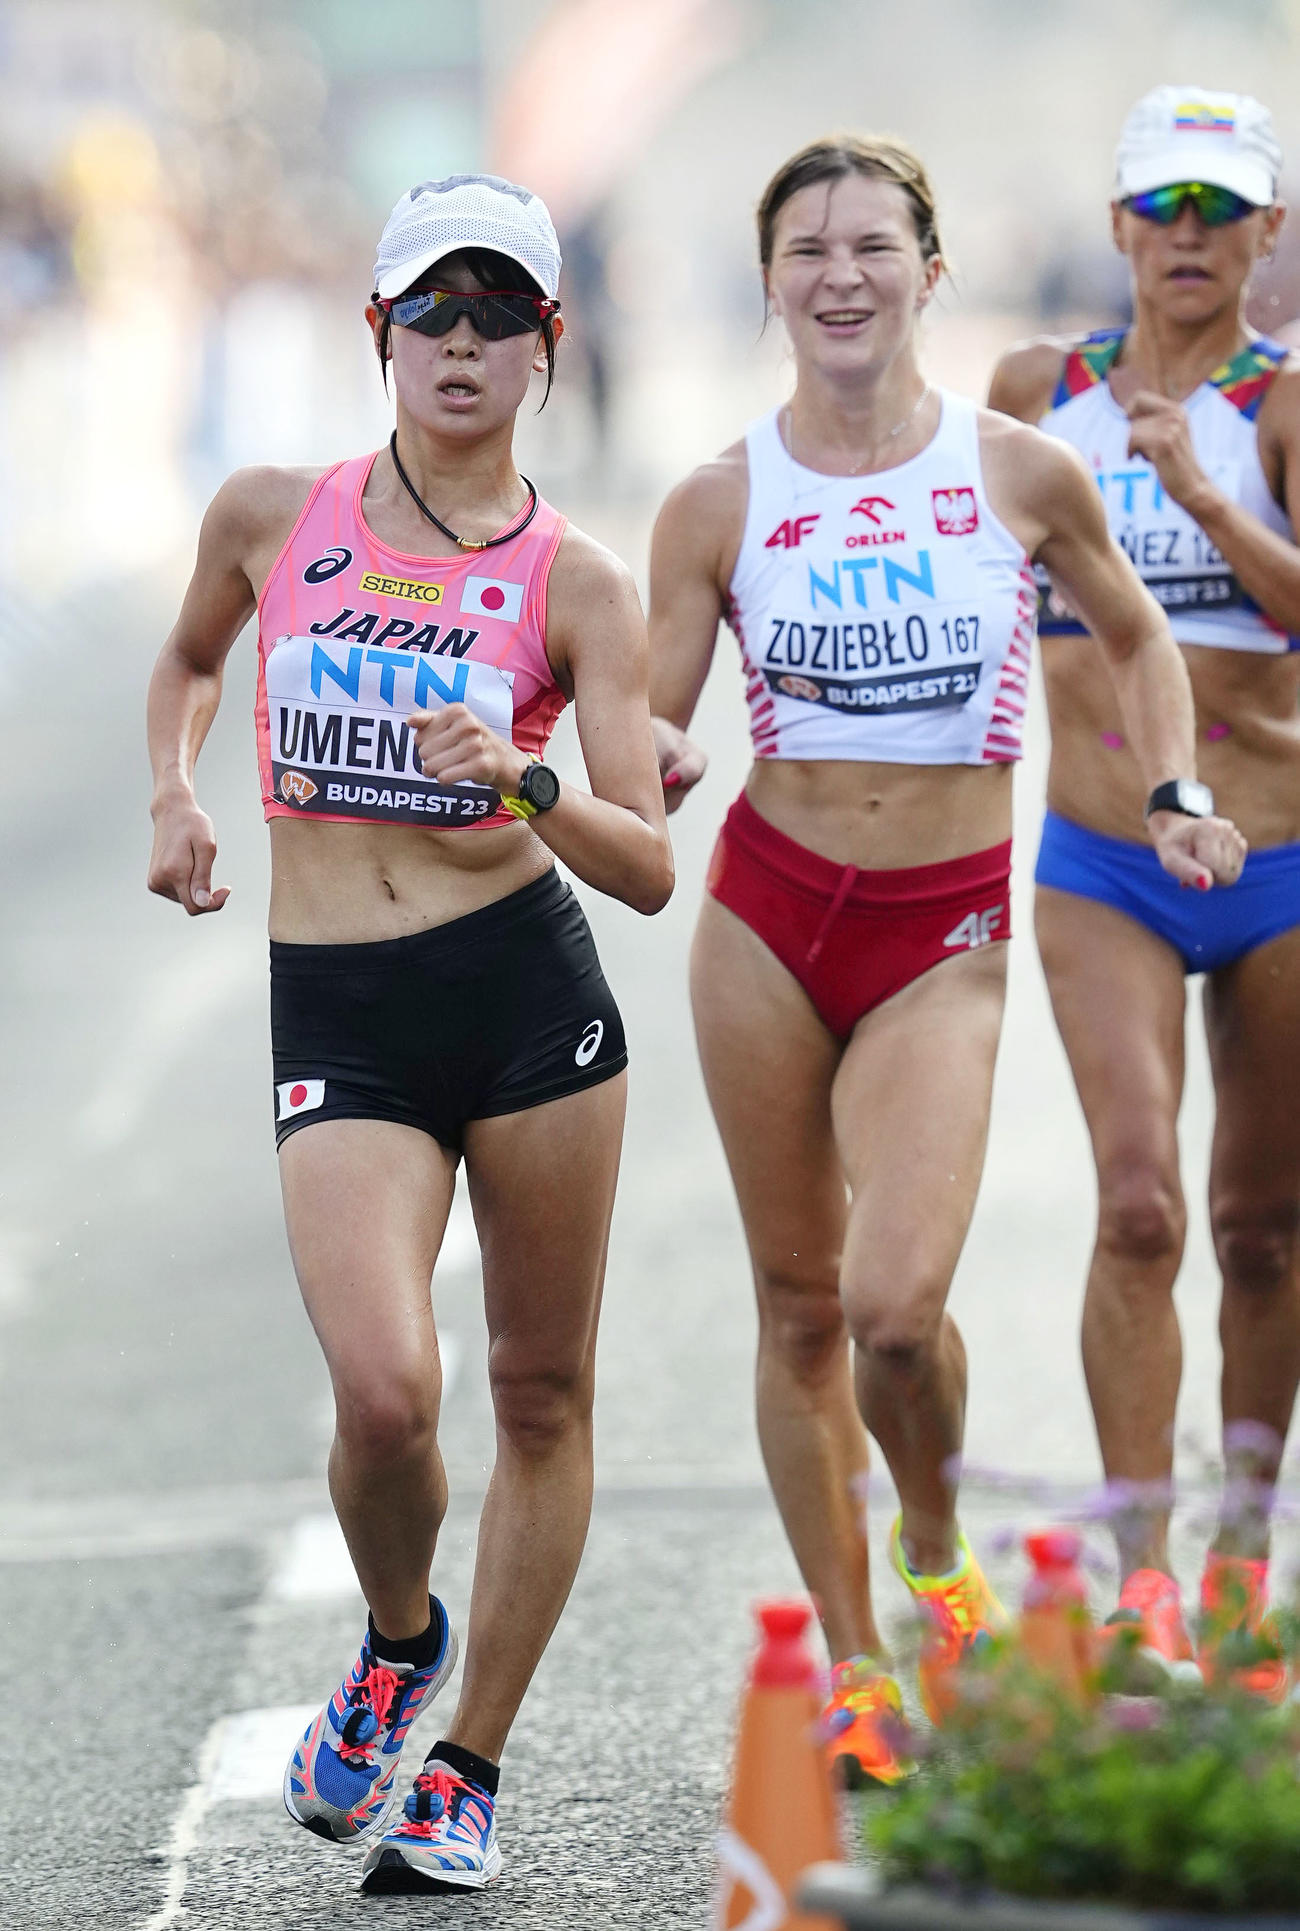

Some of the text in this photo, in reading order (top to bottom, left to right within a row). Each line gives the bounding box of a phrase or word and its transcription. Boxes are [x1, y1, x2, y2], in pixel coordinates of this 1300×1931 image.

[845, 530, 906, 549] ORLEN
[362, 575, 441, 603] SEIKO
[808, 549, 936, 610] NTN
[309, 608, 480, 659] JAPAN
[765, 615, 980, 672] ZDZIEBŁO 167
[310, 641, 471, 711] NTN
[826, 675, 951, 707] BUDAPEST
[326, 783, 490, 816] BUDAPEST 23
[943, 904, 1004, 948] 4F
